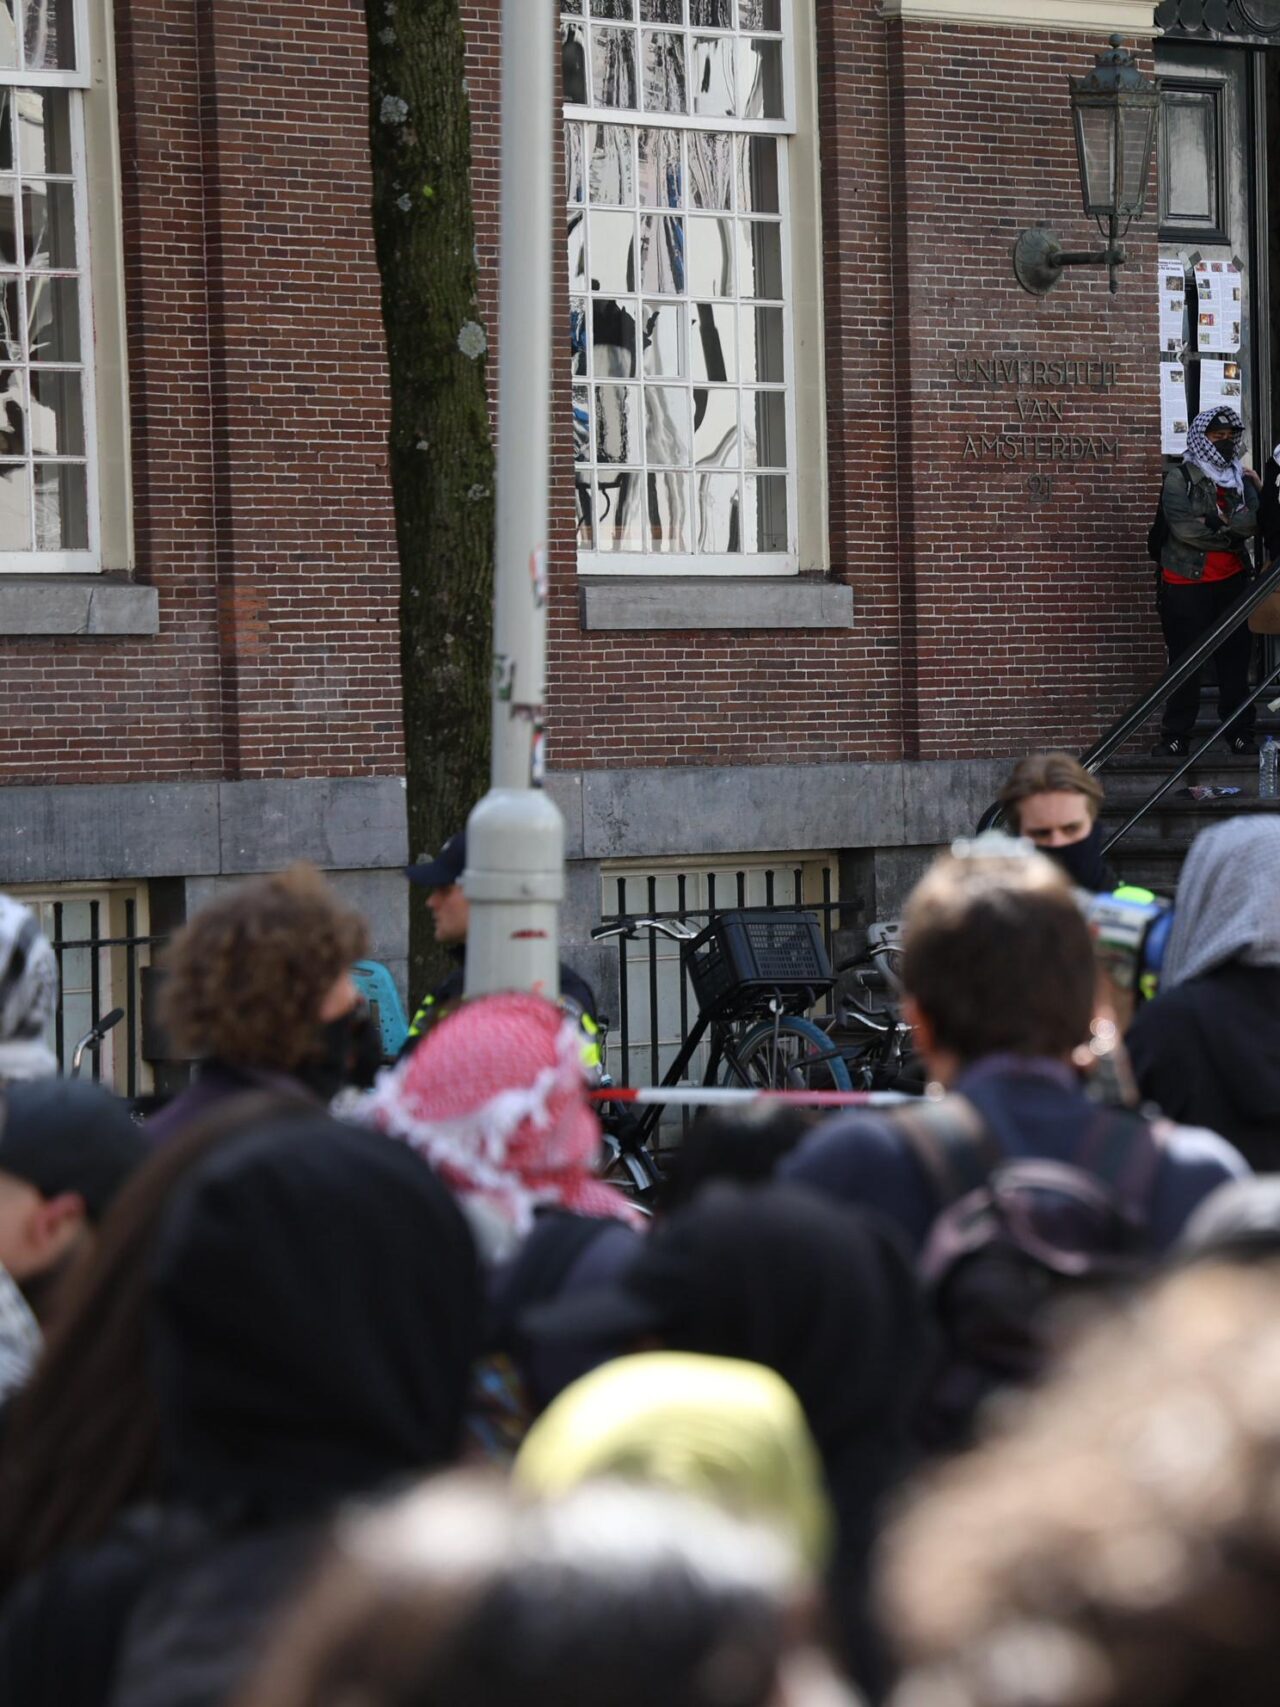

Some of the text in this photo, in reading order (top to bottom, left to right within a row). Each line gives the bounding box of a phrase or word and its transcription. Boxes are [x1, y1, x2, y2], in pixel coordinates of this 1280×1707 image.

[953, 359, 1121, 386] UNIVERSITEIT
[1016, 398, 1064, 422] VAN
[963, 435, 1120, 461] AMSTERDAM
